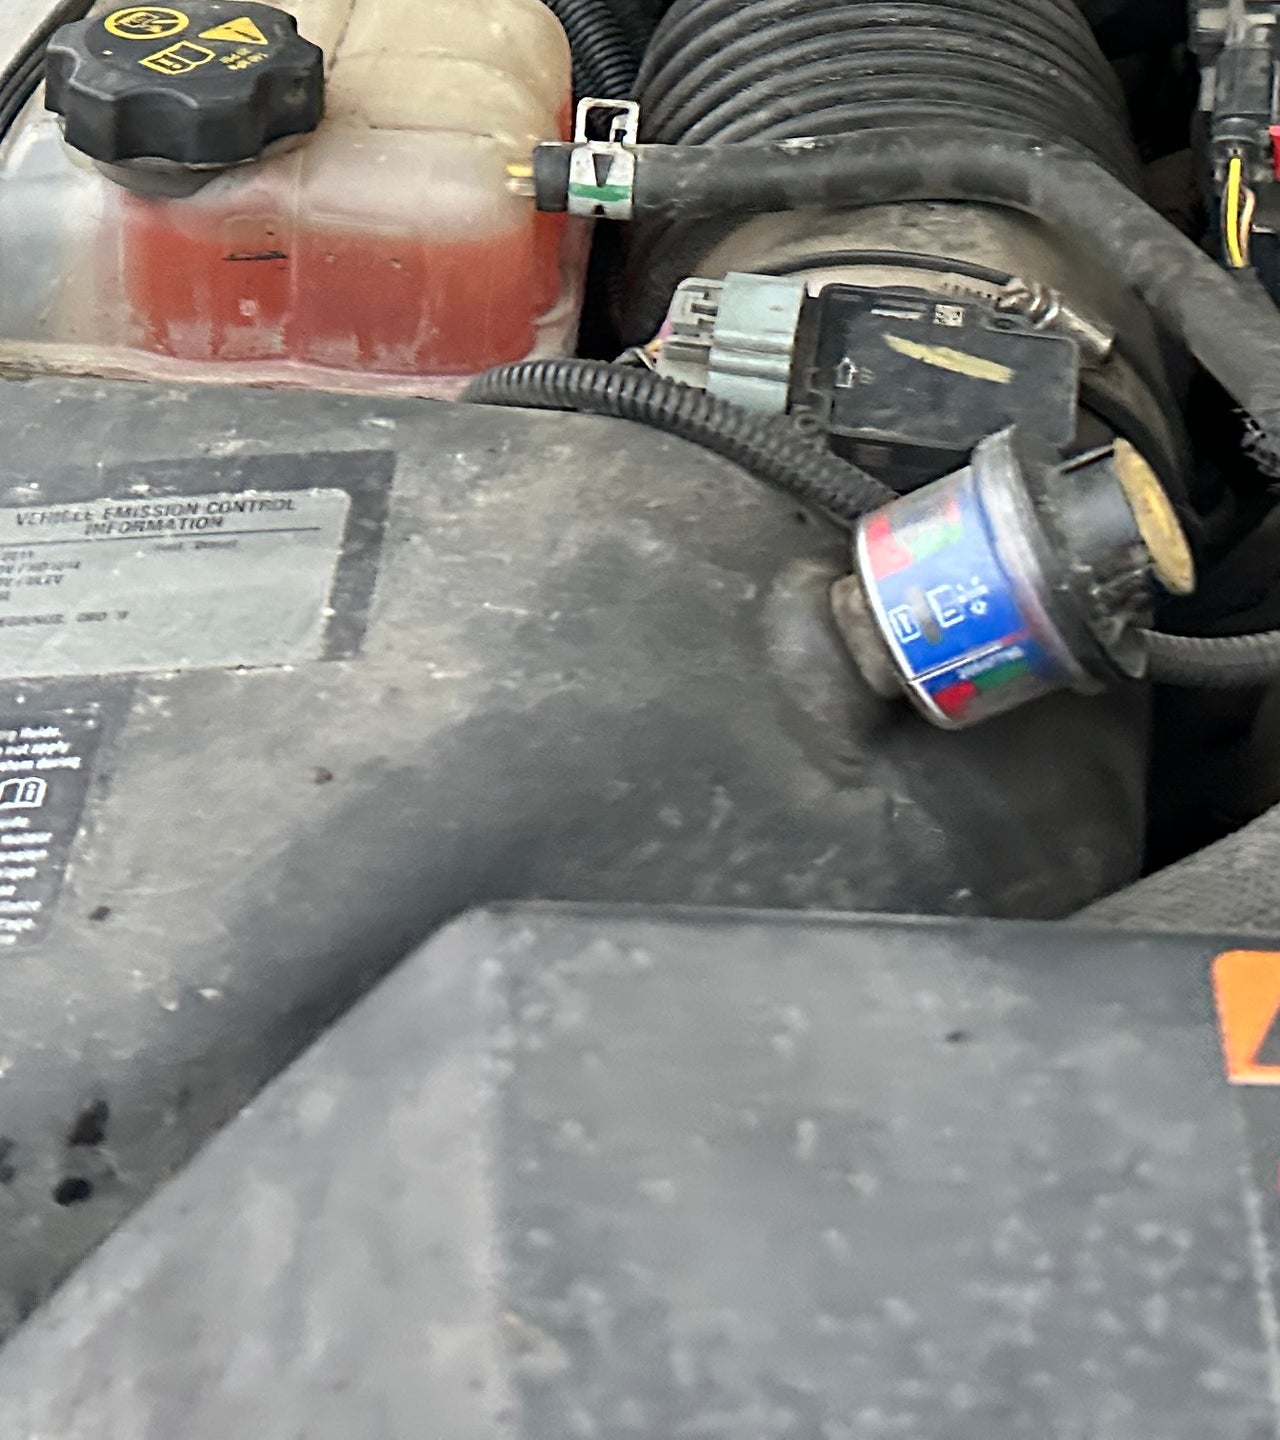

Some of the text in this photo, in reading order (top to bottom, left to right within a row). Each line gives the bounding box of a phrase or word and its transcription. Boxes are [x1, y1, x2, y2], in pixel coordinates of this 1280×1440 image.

[14, 497, 297, 526] VEHICLE EMISSION CONTROL
[84, 516, 225, 536] INFORMATION
